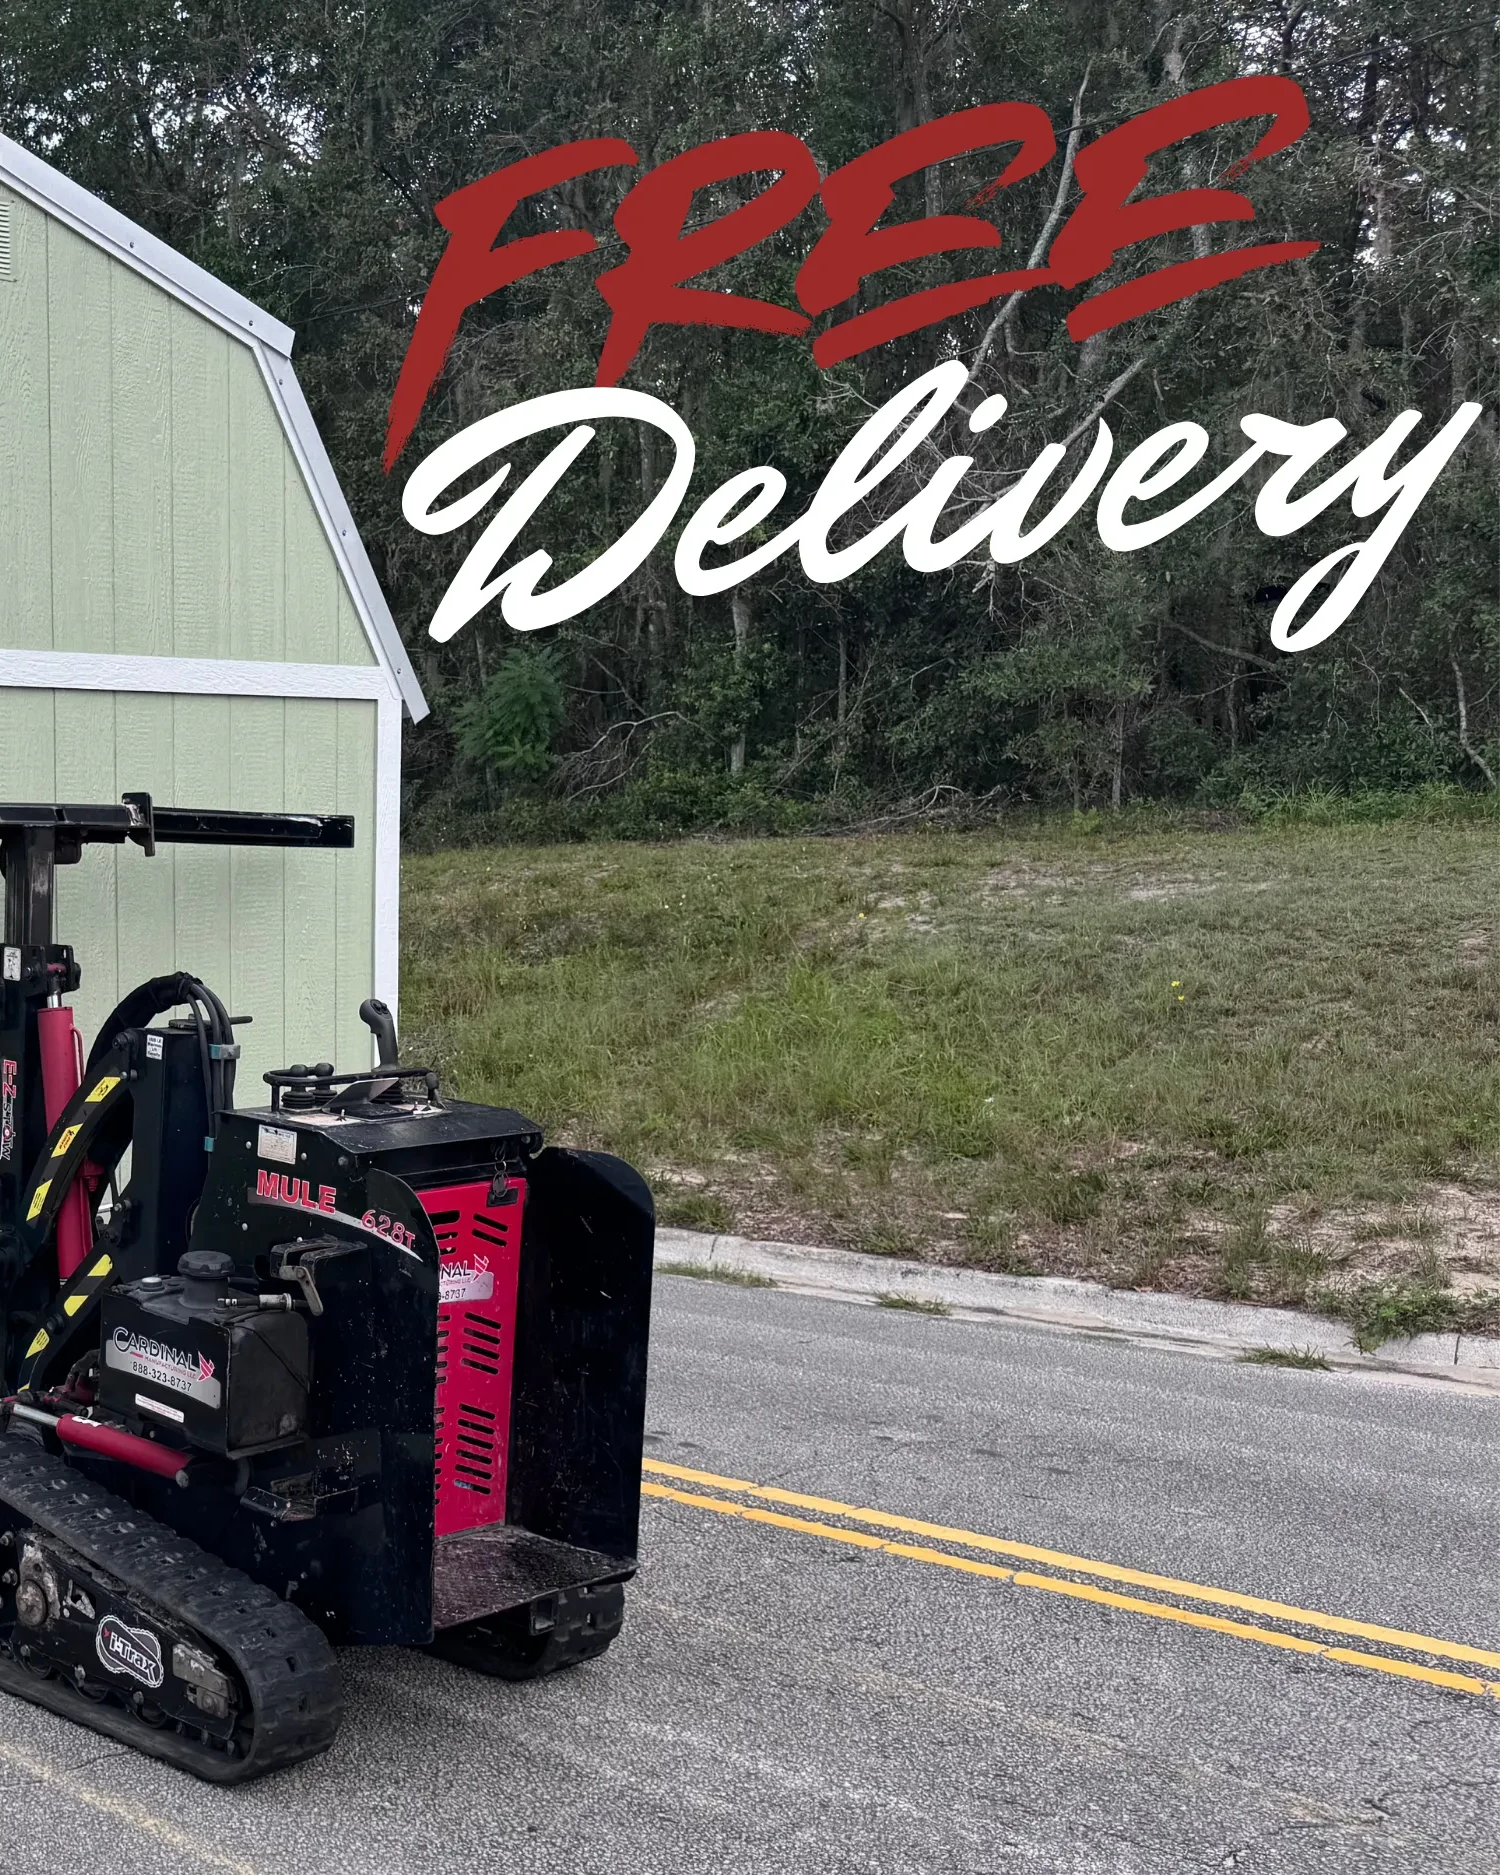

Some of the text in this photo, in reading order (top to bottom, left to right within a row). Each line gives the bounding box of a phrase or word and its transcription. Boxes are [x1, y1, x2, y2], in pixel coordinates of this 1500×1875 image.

[2, 1059, 18, 1099] E-Z
[256, 1168, 416, 1250] MULE 628T
[113, 1327, 197, 1372] CARDINAL
[132, 1361, 192, 1392] 888-323-8737
